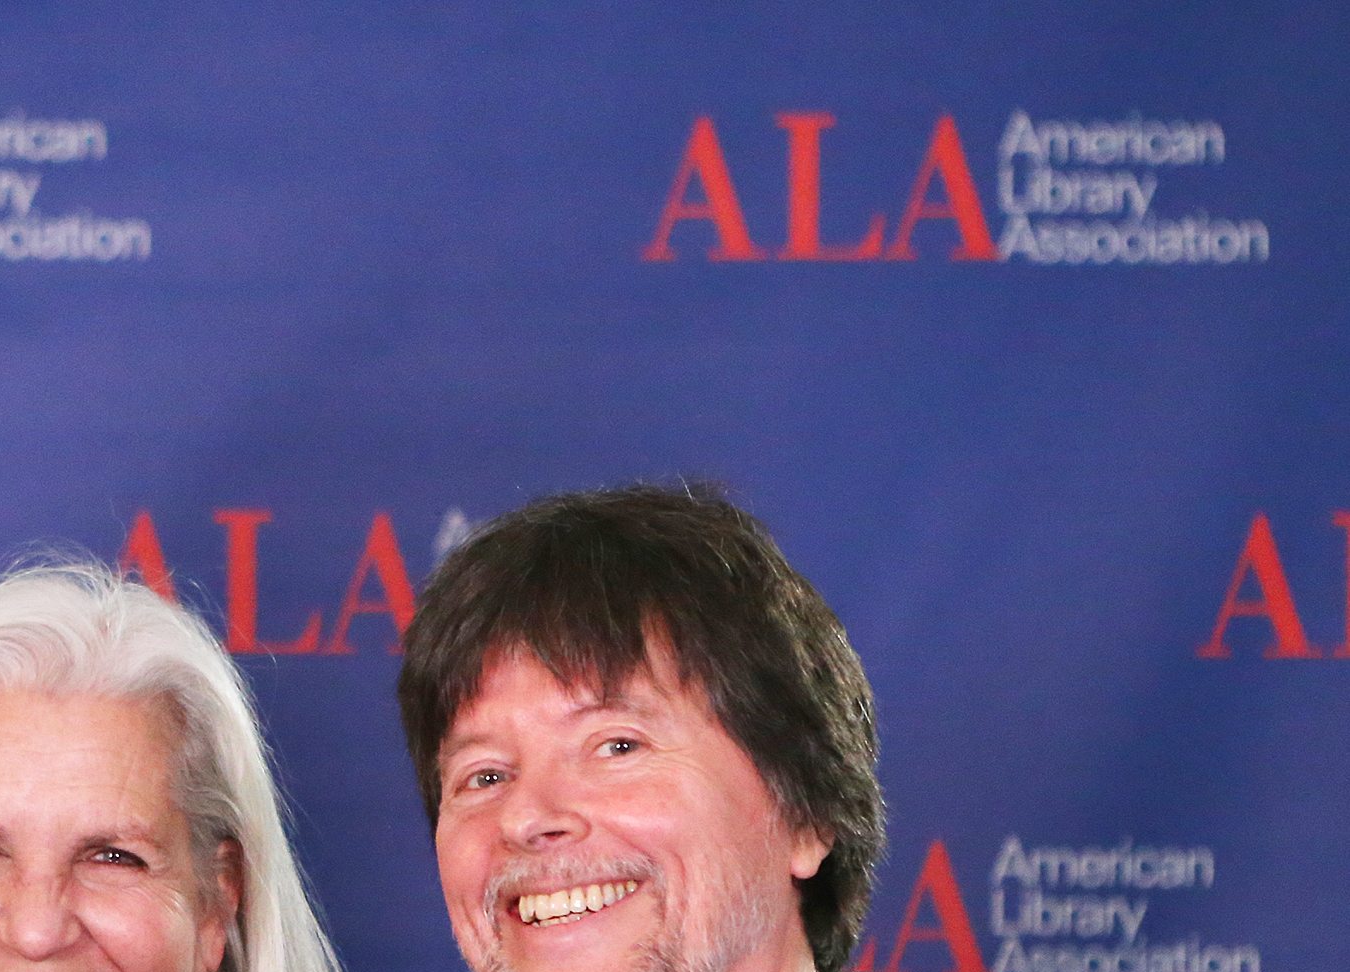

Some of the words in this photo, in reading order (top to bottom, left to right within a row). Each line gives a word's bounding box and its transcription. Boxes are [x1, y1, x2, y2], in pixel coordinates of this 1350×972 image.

[998, 108, 1225, 165] American
[641, 110, 1003, 262] ALA
[998, 163, 1157, 220] Library
[1000, 211, 1269, 264] Association
[1195, 510, 1350, 660] A
[991, 836, 1215, 888] American
[991, 884, 1147, 940] Library
